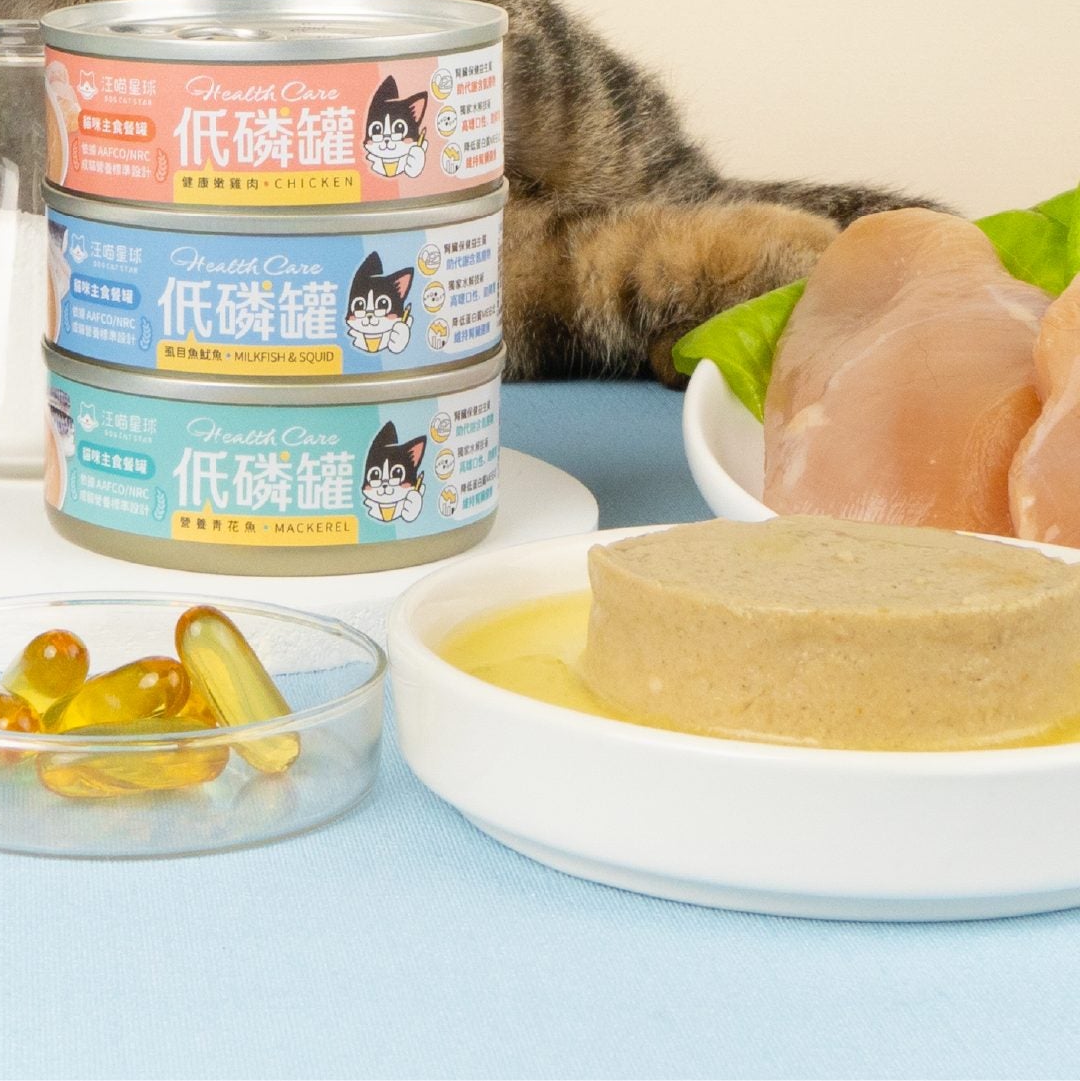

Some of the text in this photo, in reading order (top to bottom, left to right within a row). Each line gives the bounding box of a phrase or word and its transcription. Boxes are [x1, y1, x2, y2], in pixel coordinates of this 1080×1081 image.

[101, 75, 157, 96] 汪喵星球
[185, 75, 341, 103] Health Care
[83, 115, 148, 136] 貓咪主食餐罐
[173, 106, 356, 168] 低磷罐
[98, 146, 151, 161] AAFCO/NRC
[182, 176, 353, 190] 健康嫩雞肉 CHICKEN
[90, 241, 142, 264] 汪喵星球
[170, 246, 323, 276] Health Care
[73, 278, 133, 304] 貓咪主食餐罐
[86, 310, 136, 329] AAFCO/NRC
[158, 277, 338, 341] 低磷罐
[164, 345, 334, 364] 虱目魚魷魚 MILKFISH & SQUID
[102, 410, 157, 434] 汪喵星球
[186, 417, 341, 447] Health Care
[82, 447, 148, 475] 貓咪主食餐罐
[96, 479, 150, 500] AAFCO/NRC
[173, 447, 355, 512] 低磷罐
[180, 516, 350, 533] 營養青花魚 MACKEREL
